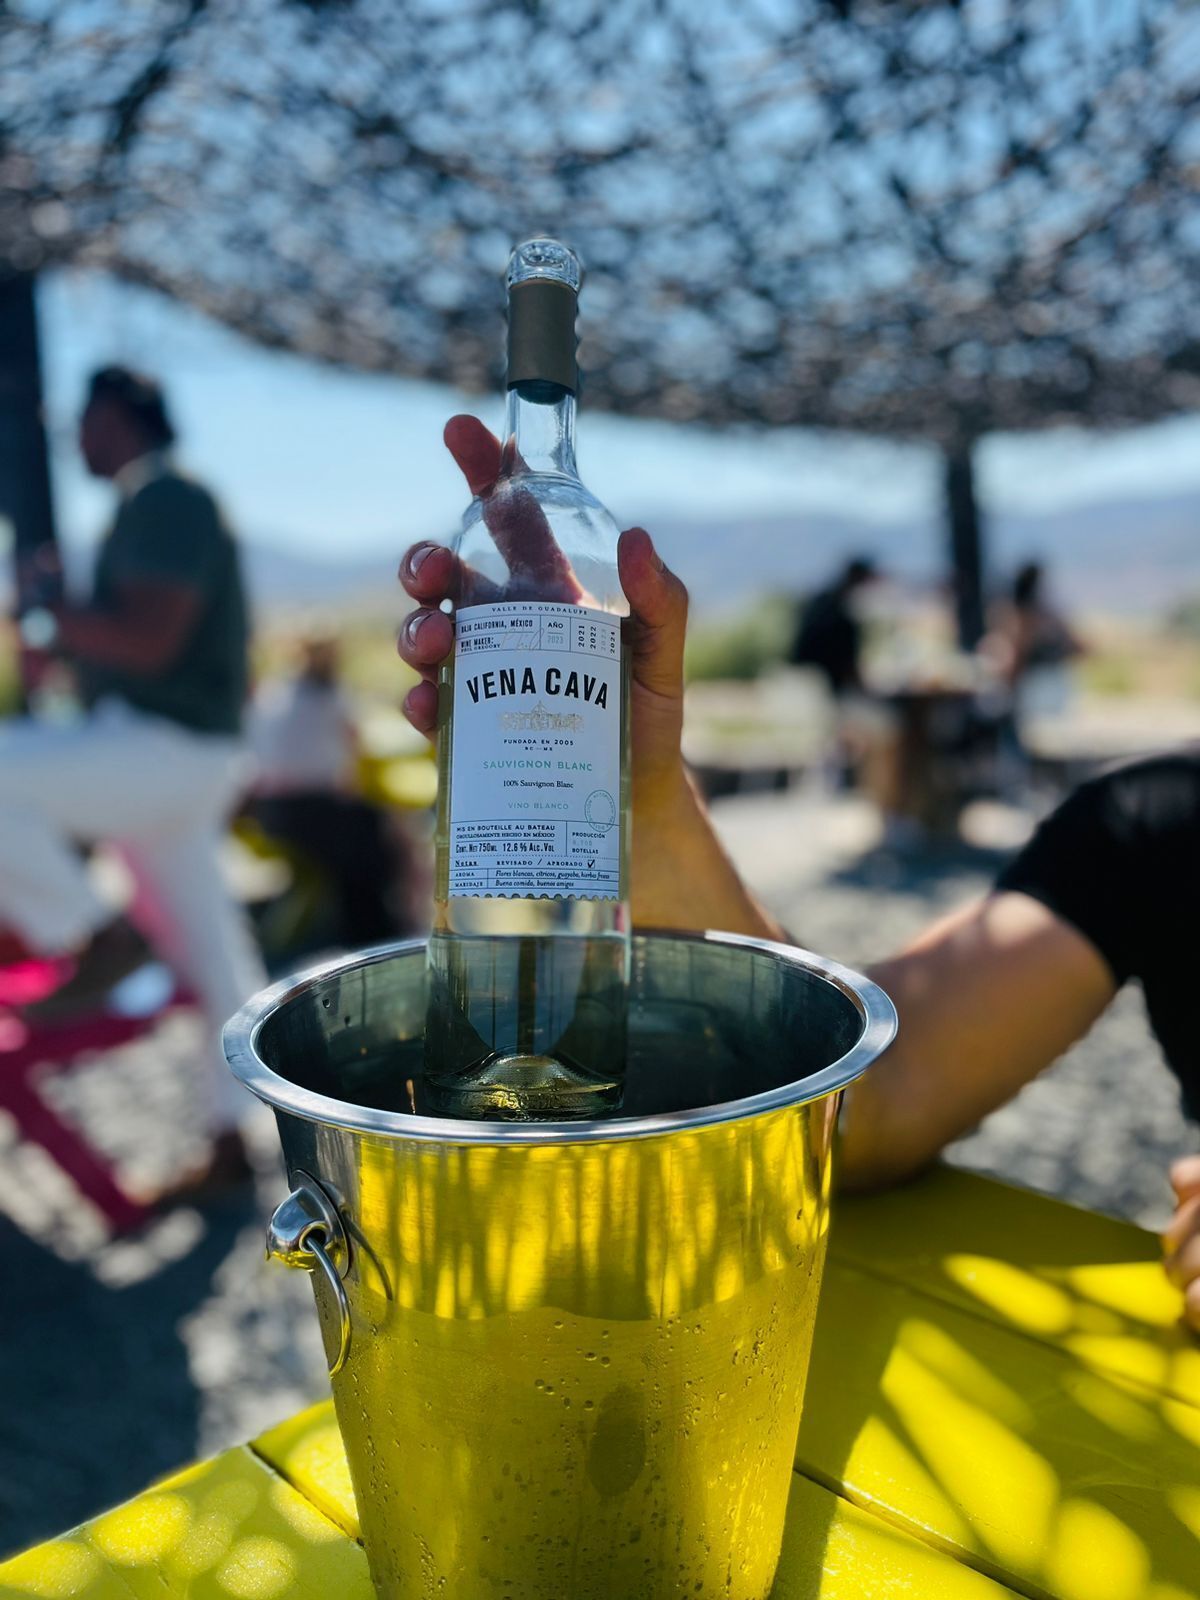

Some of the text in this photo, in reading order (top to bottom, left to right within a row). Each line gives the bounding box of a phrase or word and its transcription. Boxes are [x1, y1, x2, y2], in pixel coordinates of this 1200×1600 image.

[538, 605, 588, 616] GUADALUPE
[461, 618, 533, 634] BAJA CALIFORNIA, MÉXICO
[547, 621, 564, 629] AÑO
[461, 639, 472, 649] WINE
[474, 637, 494, 646] MAKER:
[547, 635, 564, 645] 2023
[589, 626, 597, 650] 2022
[466, 667, 608, 710] VENA CAVA
[483, 760, 593, 772] SAUVIGNON BLANC
[520, 780, 555, 790] Sauvignon
[556, 781, 574, 789] Blanc
[502, 842, 518, 852] 12.6
[520, 843, 527, 852] %
[495, 869, 512, 877] Flores
[512, 869, 535, 877] blancas,
[495, 879, 513, 887] Buena
[513, 880, 535, 888] comida,
[556, 881, 574, 889] amigos
